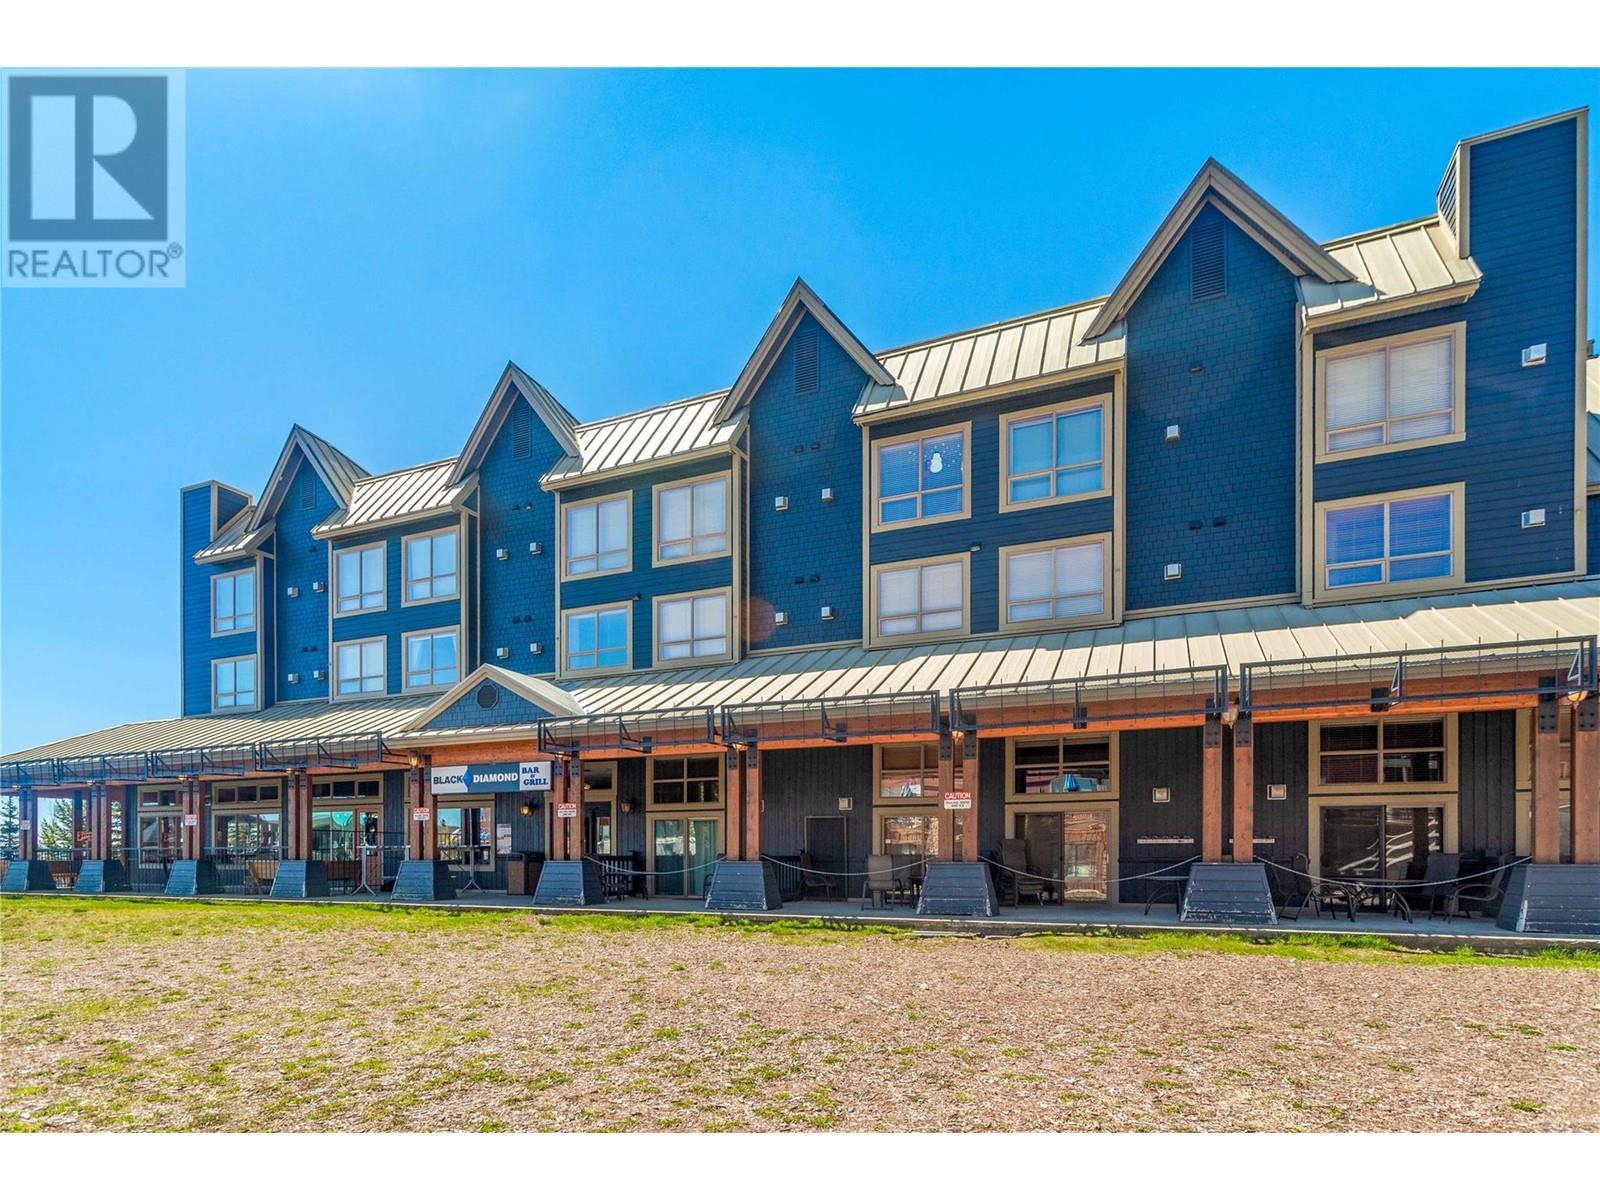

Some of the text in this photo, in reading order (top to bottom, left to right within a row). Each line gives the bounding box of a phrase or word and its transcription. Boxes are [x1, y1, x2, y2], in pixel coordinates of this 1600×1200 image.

[433, 773, 518, 785] BLACK DIAMOND
[523, 778, 548, 786] GRILL
